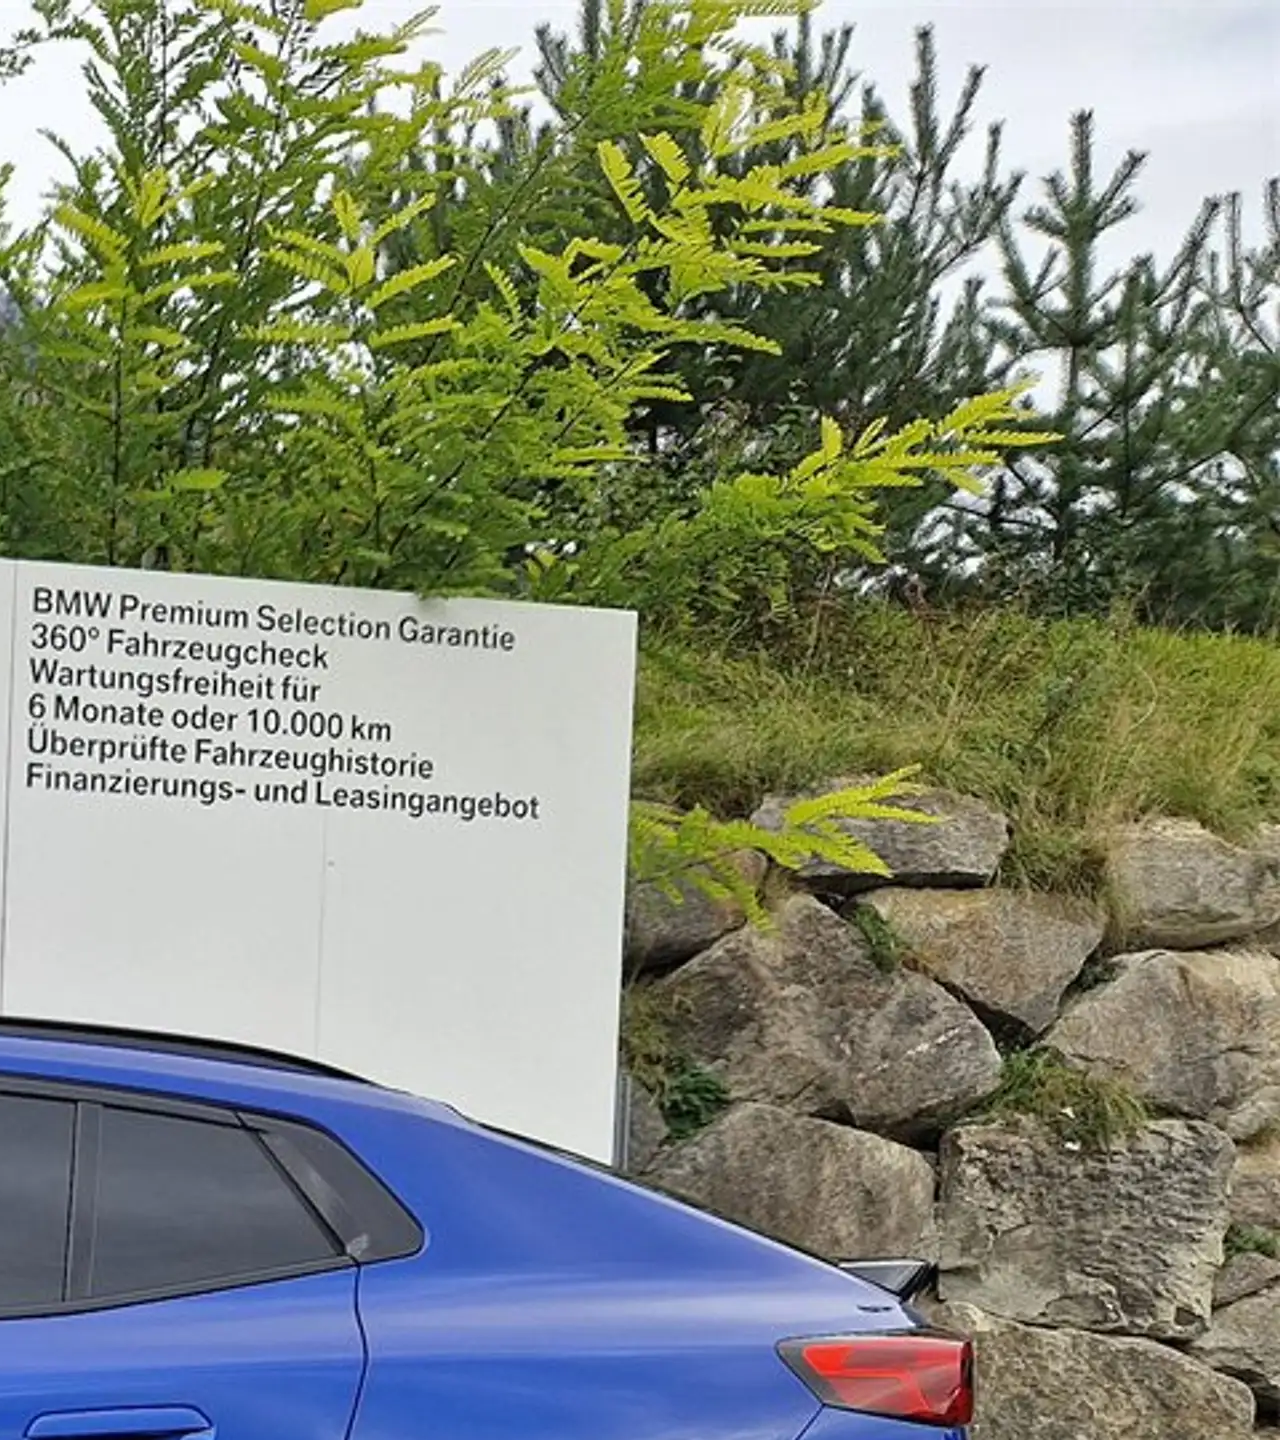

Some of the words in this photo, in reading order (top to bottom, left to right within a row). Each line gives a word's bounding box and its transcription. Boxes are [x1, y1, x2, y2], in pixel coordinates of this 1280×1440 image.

[32, 586, 113, 619] BMW
[119, 593, 249, 630] Premium
[256, 604, 391, 641] Selection
[398, 615, 517, 652] Garantie
[30, 622, 101, 654] 360°
[106, 628, 330, 672] Fahrzeugcheck
[29, 657, 276, 701] Wartungsfreiheit
[281, 674, 322, 704] für
[28, 692, 47, 719] 6
[53, 694, 165, 729] Monate
[171, 704, 239, 733] oder
[247, 707, 345, 741] 10.000
[351, 714, 392, 744] km
[27, 726, 188, 767] Überprüfte
[193, 738, 436, 782] Fahrzeughistorie
[25, 761, 247, 807] Finanzierungs-
[253, 780, 309, 806] und
[314, 780, 541, 823] Leasingangebot
